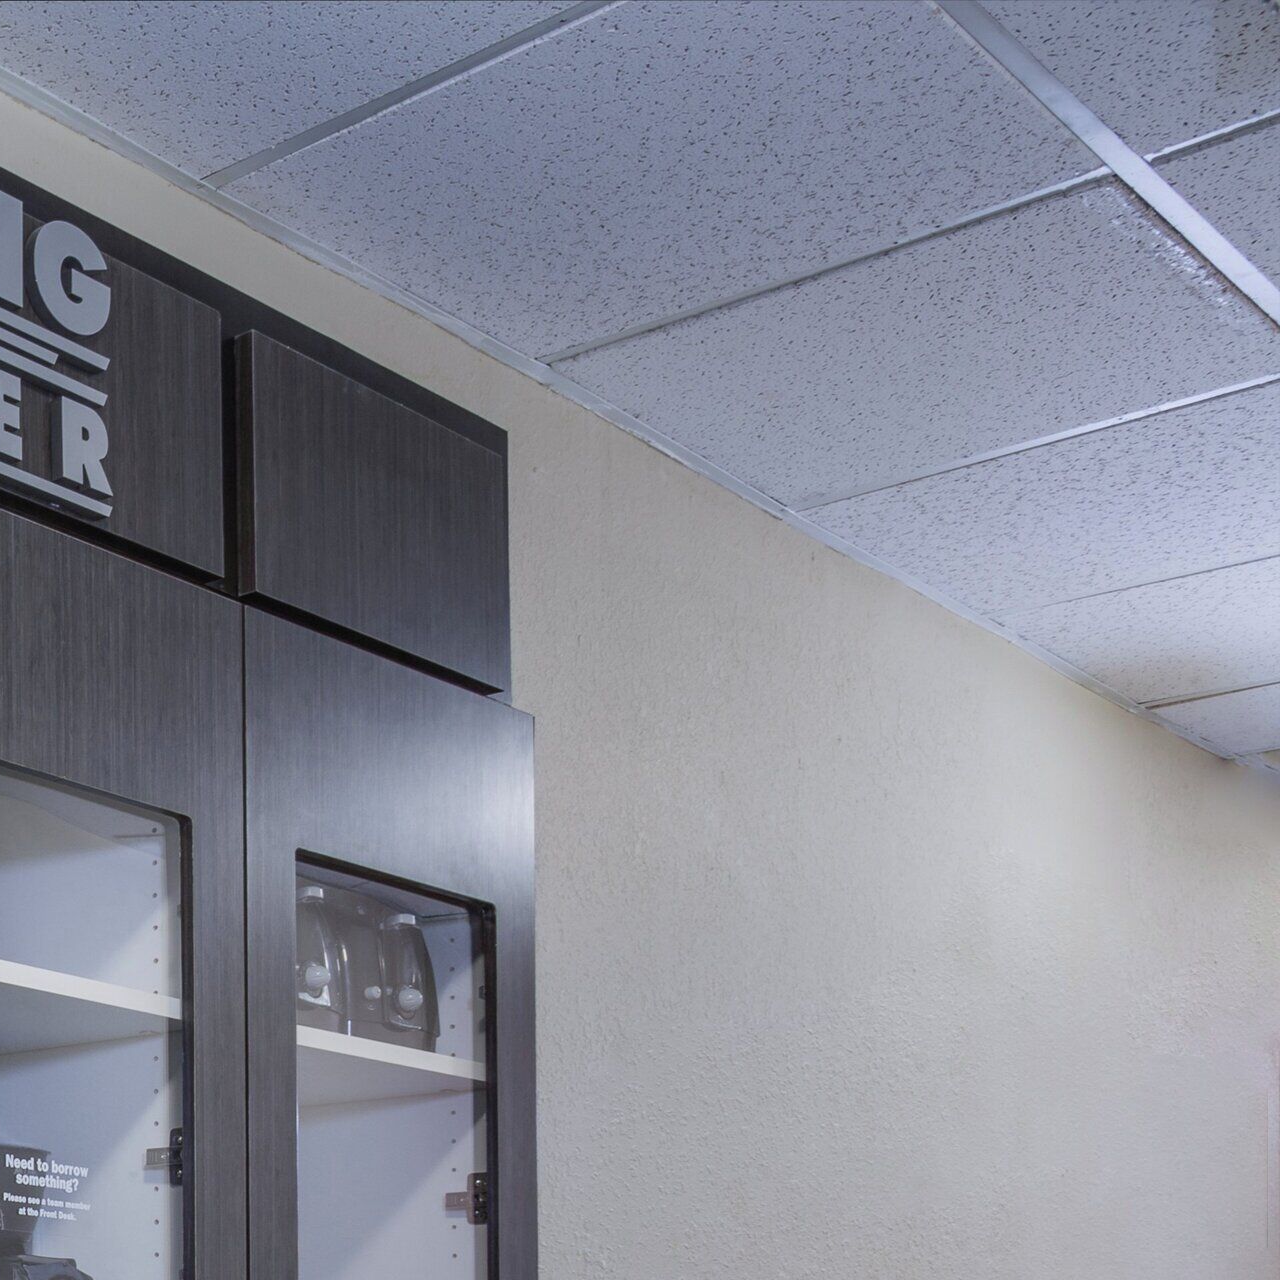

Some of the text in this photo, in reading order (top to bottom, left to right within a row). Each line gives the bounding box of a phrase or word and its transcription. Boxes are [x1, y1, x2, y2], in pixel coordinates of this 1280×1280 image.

[5, 1153, 89, 1178] Need to borrow
[15, 1173, 79, 1194] something?
[3, 1192, 27, 1203] Please
[28, 1196, 40, 1205] see
[47, 1198, 64, 1208] team
[65, 1200, 92, 1211] member
[18, 1207, 78, 1221] at the Front Desk.
